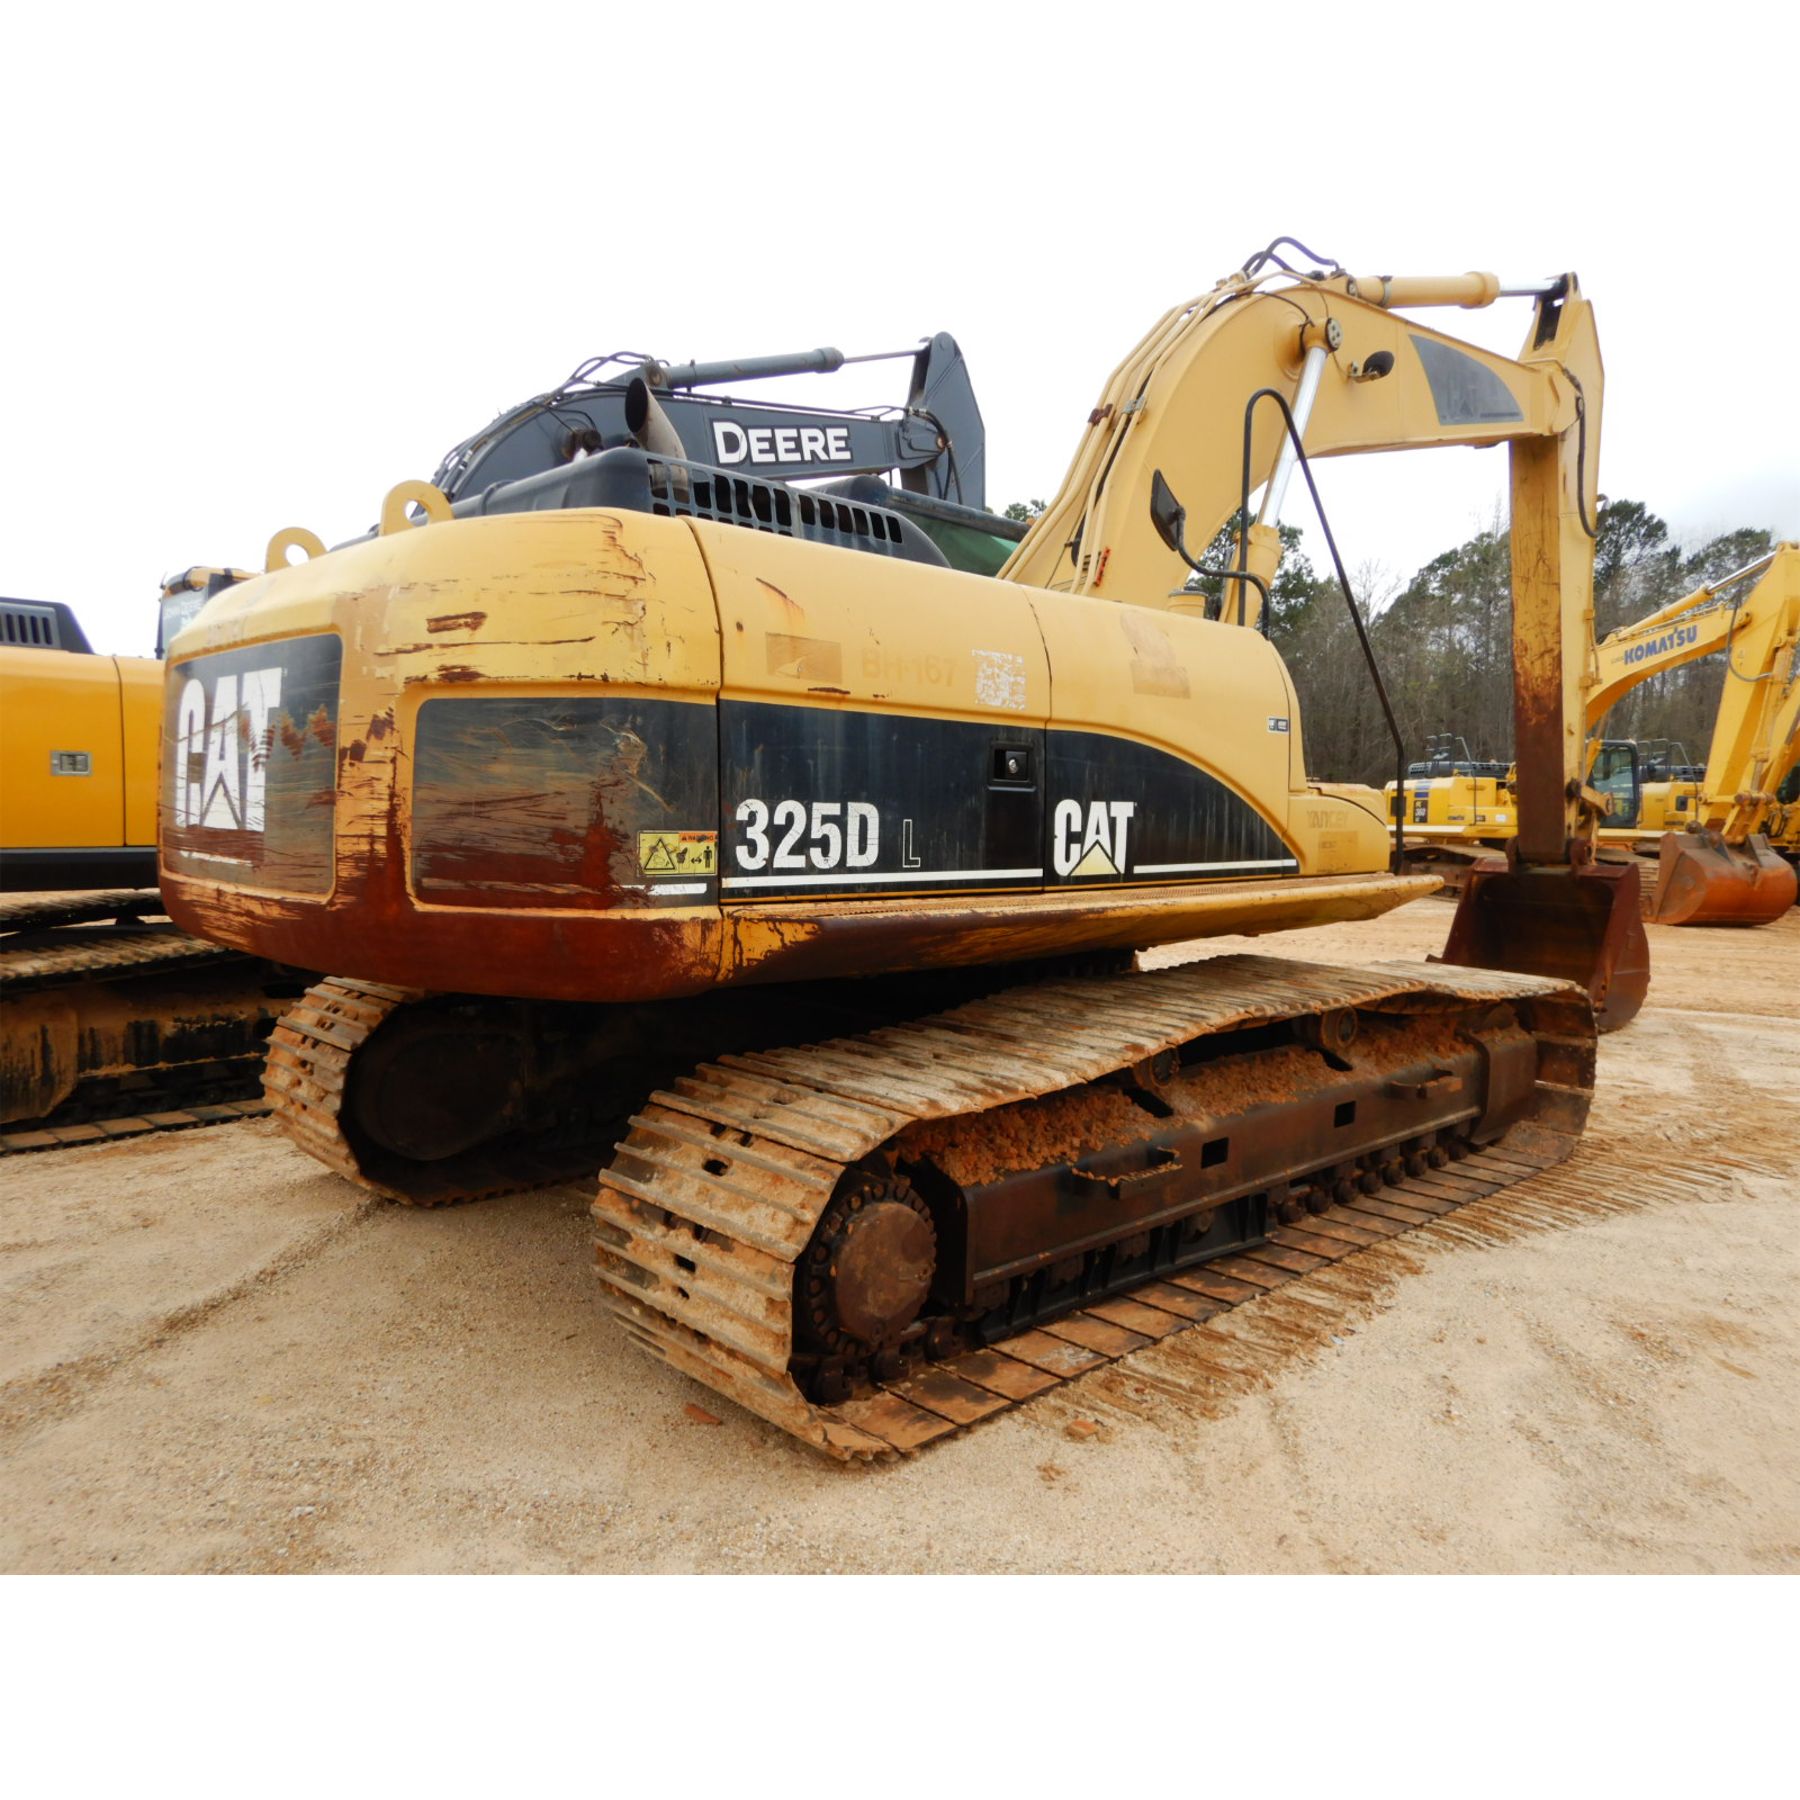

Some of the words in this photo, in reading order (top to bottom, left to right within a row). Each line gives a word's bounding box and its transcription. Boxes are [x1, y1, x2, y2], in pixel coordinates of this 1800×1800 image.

[712, 421, 852, 464] DEERE
[1624, 625, 1697, 665] KOMATSU
[175, 667, 282, 832] CAT
[735, 799, 879, 870] 325D
[903, 819, 921, 868] L
[1054, 799, 1134, 877] CAT
